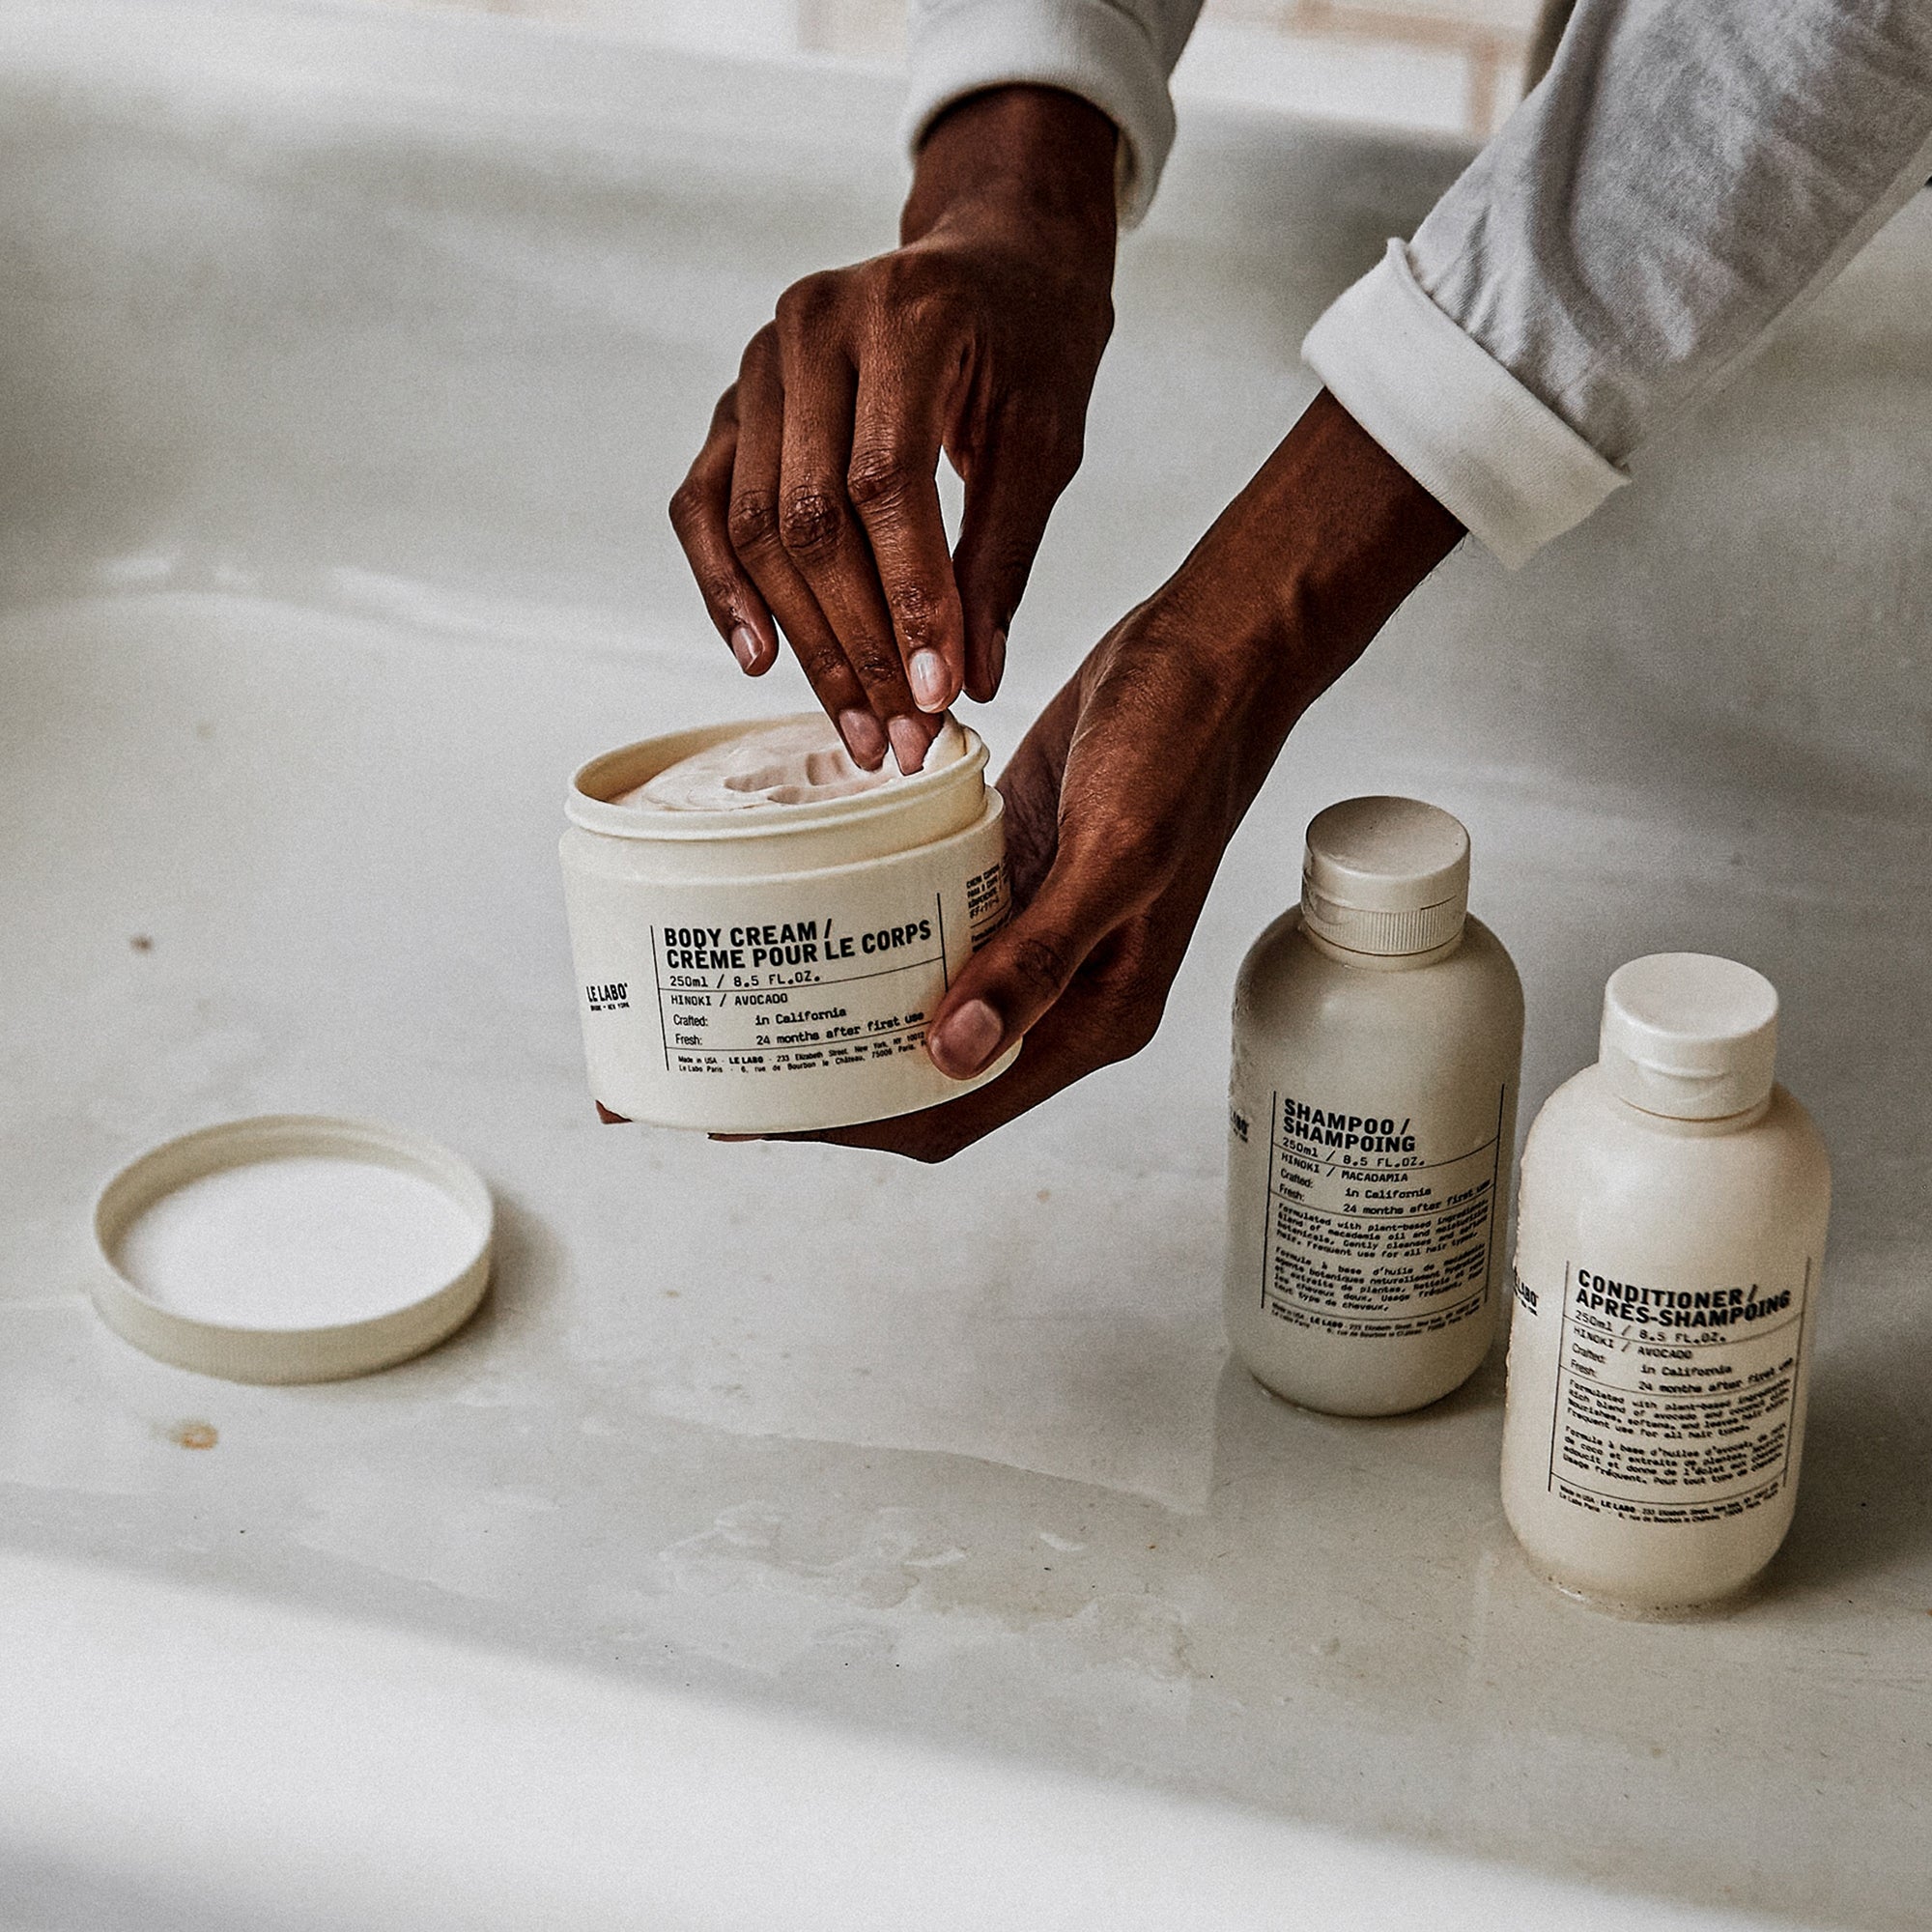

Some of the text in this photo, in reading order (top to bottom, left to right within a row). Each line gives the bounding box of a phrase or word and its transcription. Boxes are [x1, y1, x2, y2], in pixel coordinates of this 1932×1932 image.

[664, 927, 722, 948] BODY
[729, 921, 817, 947] CREAM
[667, 920, 931, 969] CRÈME POUR LE CORPS
[669, 971, 820, 989] 250ml / 8.5 FL.OZ.
[585, 985, 598, 1002] LE
[671, 993, 788, 1008] HINOKI / AVOCADO
[673, 1008, 847, 1027] Crafted: in California
[675, 1011, 924, 1046] Fresh: 24 months after first use
[678, 1055, 694, 1064] Made
[742, 1056, 764, 1065] LABO
[1284, 1097, 1394, 1134] SHAMPOO
[1283, 1116, 1416, 1153] SHAMPOING
[1283, 1137, 1425, 1168] 250ml / 8.5 FL.OZ.
[1281, 1152, 1408, 1182] HINOKI / MACADAMIA
[1280, 1168, 1432, 1200] Crafted: in California
[1279, 1183, 1305, 1203] Fresh:
[1343, 1204, 1357, 1213] 24
[1363, 1205, 1404, 1215] months
[1409, 1200, 1442, 1213] after
[1446, 1189, 1473, 1207] first
[1278, 1202, 1332, 1226] Formulated
[1337, 1221, 1362, 1231] with
[1368, 1220, 1432, 1232] plant-based
[1327, 1229, 1381, 1241] macadamia
[1388, 1232, 1406, 1240] oil
[1413, 1229, 1431, 1238] and
[1343, 1239, 1378, 1251] Gently
[1386, 1238, 1432, 1249] cleanses
[1438, 1232, 1455, 1242] and
[1404, 1248, 1421, 1257] all
[1426, 1243, 1447, 1254] hair
[1337, 1264, 1362, 1275] base
[1423, 1264, 1435, 1272] de
[1341, 1283, 1353, 1292] de
[1380, 1294, 1410, 1303] Usage
[1578, 1268, 1743, 1310] CONDITIONER
[1324, 1298, 1337, 1308] de
[1576, 1288, 1791, 1328] APRÈS-SHAMPOING
[1576, 1309, 1613, 1333] 250ml
[1621, 1324, 1632, 1337] /
[1639, 1329, 1666, 1342] 8.5
[1574, 1326, 1692, 1359] HINOKI / AVOCADO
[1640, 1364, 1656, 1375] in
[1662, 1364, 1733, 1377] California
[1659, 1382, 1703, 1393] months
[1708, 1378, 1743, 1392] after
